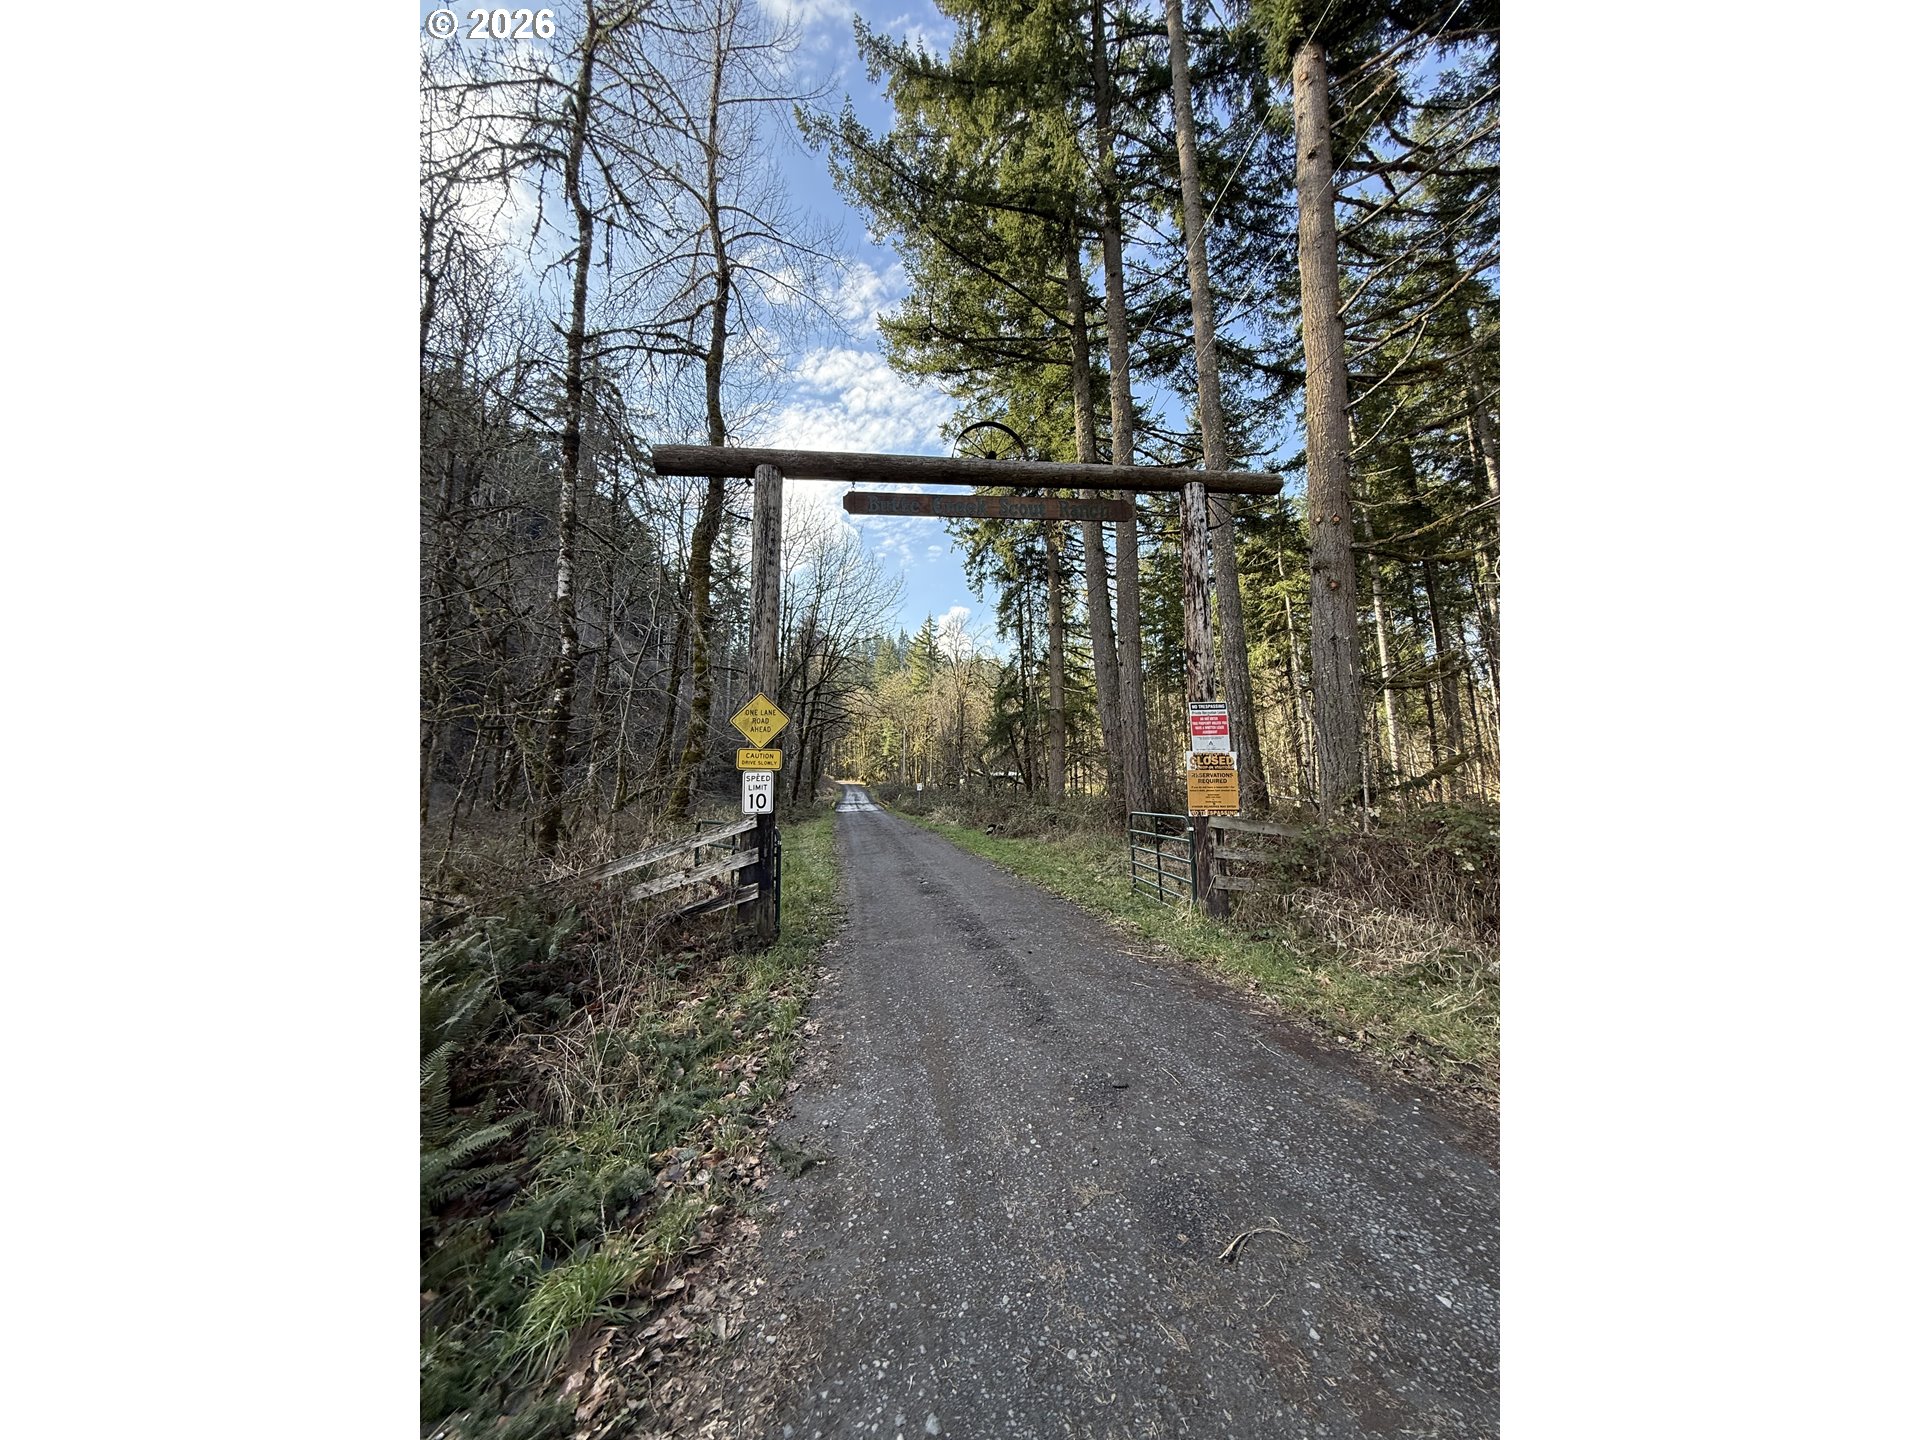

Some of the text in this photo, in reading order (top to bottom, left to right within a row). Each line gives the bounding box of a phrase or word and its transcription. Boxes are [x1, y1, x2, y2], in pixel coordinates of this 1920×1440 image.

[931, 496, 988, 516] Creek
[998, 498, 1046, 516] Scout
[1058, 500, 1109, 518] Ranch
[1189, 755, 1235, 766] CLOSED
[749, 793, 767, 809] 10
